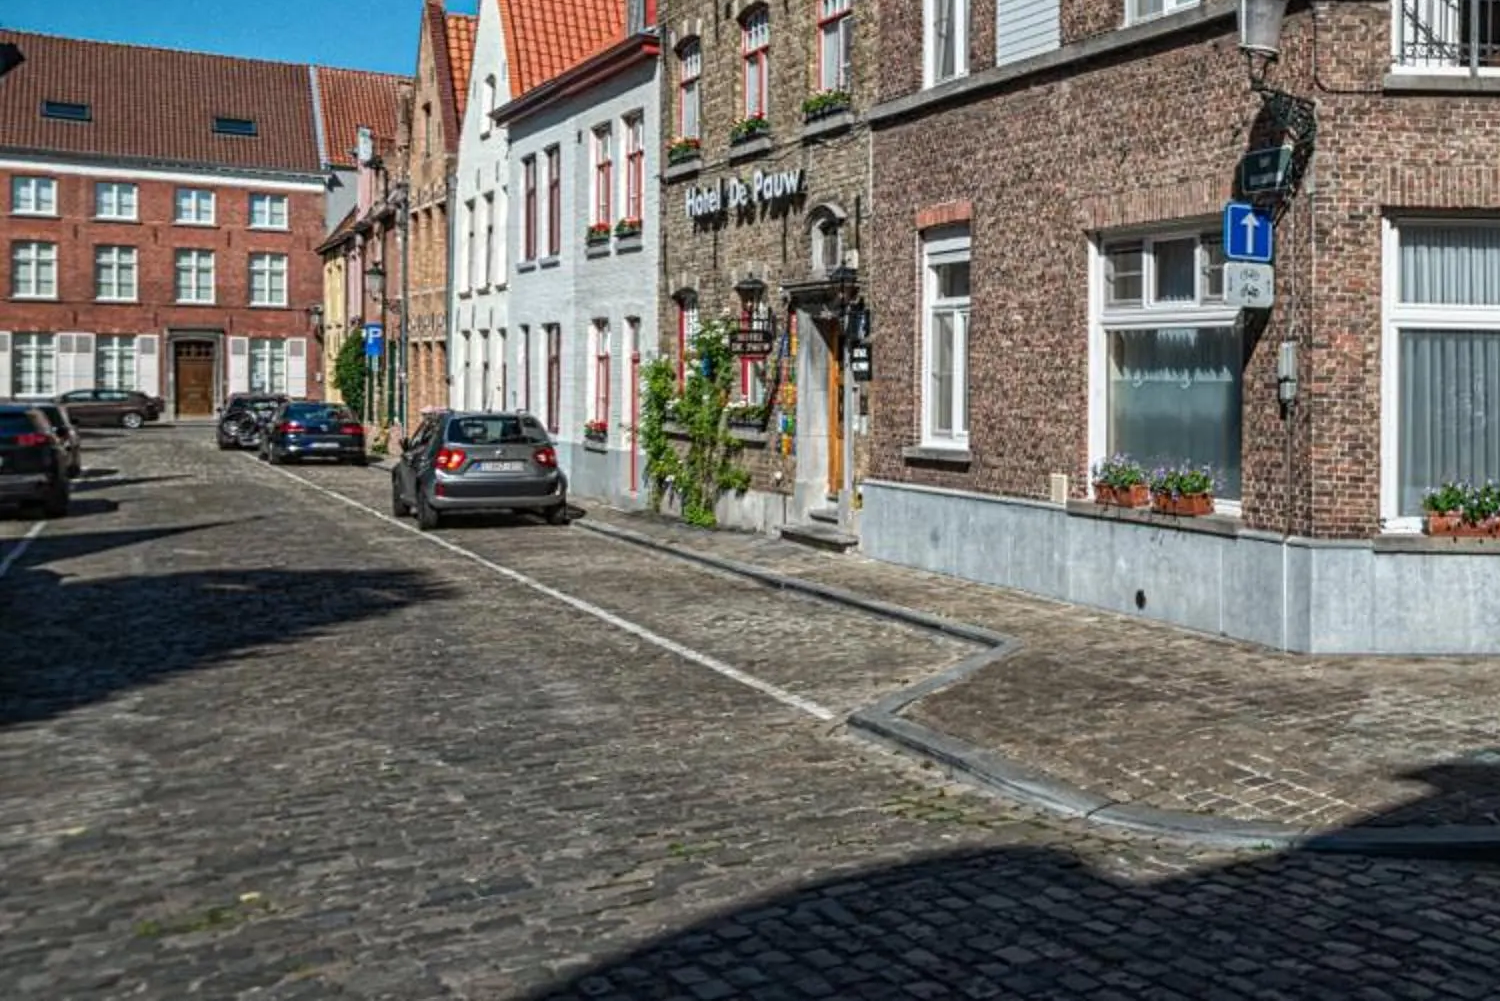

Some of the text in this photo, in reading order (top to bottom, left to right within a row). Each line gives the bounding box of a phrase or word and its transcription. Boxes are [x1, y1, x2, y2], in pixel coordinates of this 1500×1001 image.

[685, 168, 800, 218] Hotel De Pauw
[368, 326, 382, 344] P
